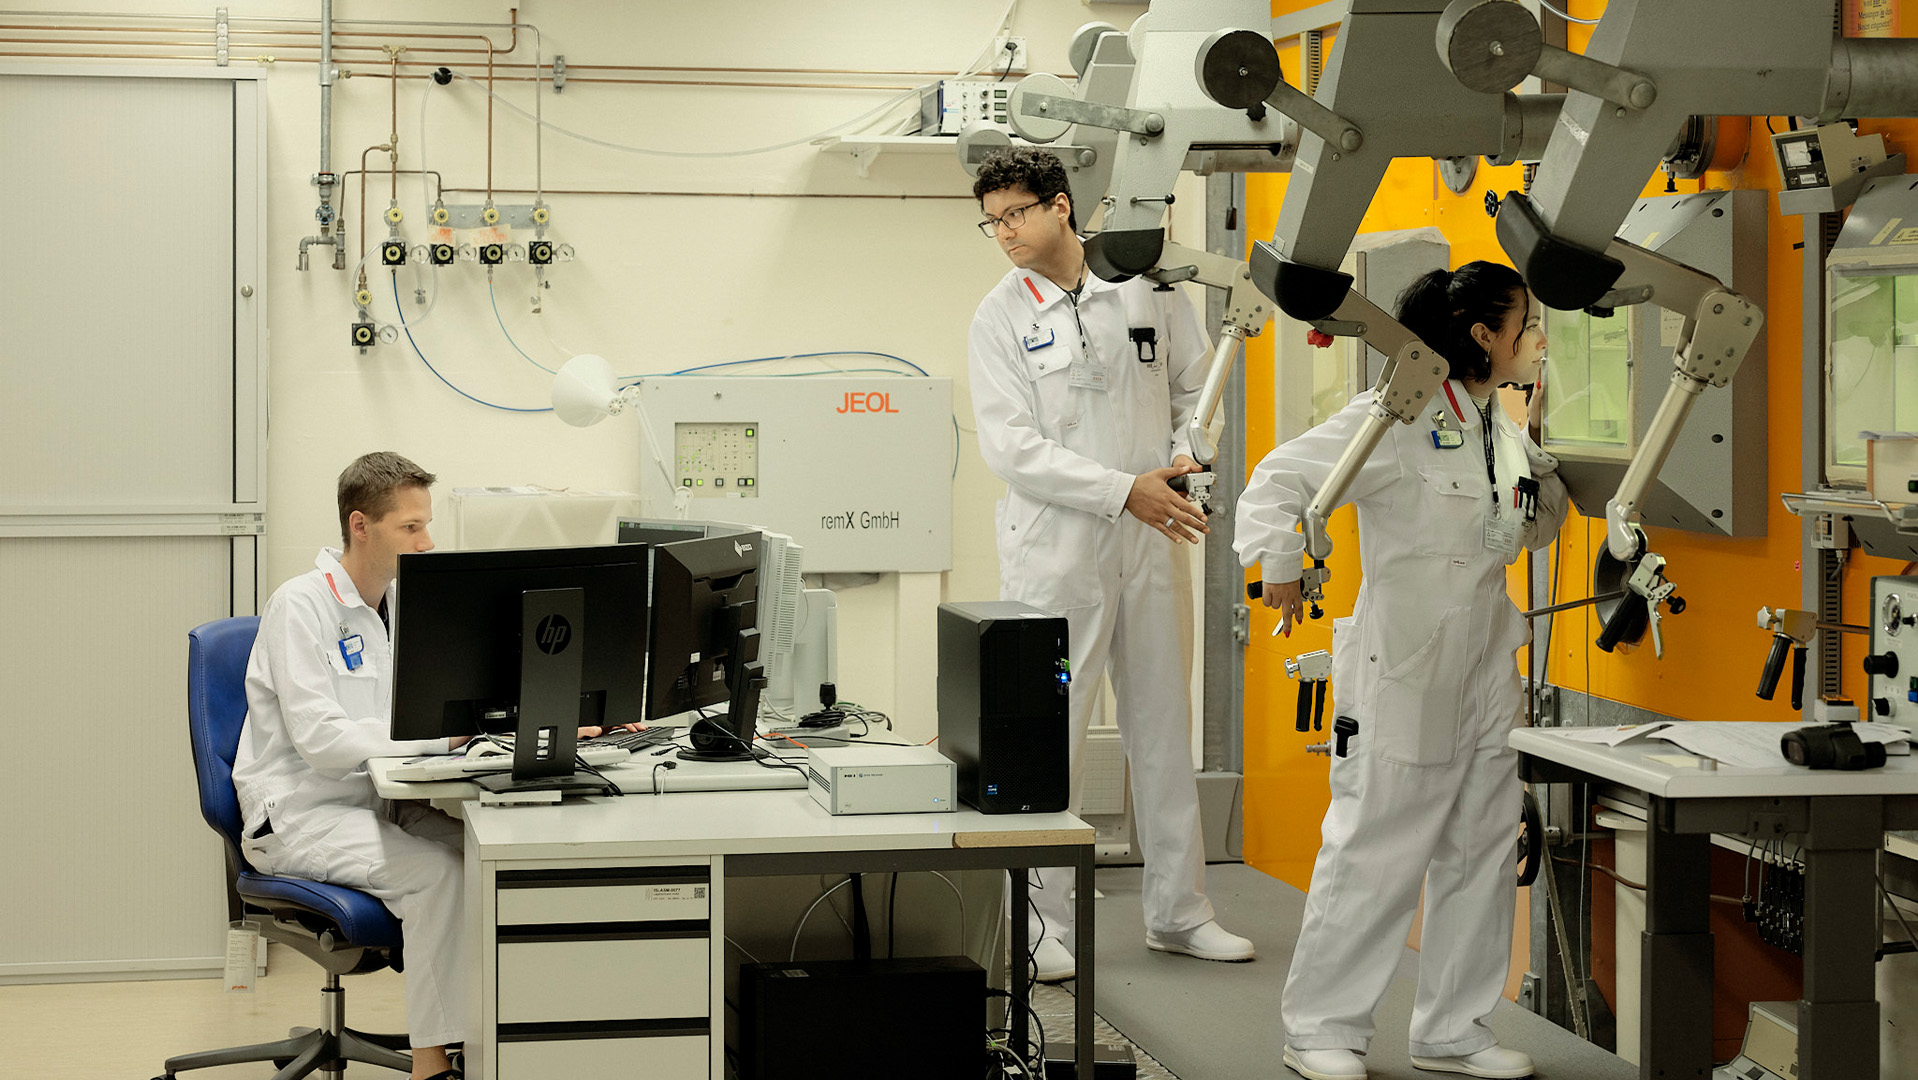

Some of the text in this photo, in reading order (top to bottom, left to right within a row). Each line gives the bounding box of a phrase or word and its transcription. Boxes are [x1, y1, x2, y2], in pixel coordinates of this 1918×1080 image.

[836, 392, 900, 414] JEOL
[821, 511, 900, 530] remX GmbH
